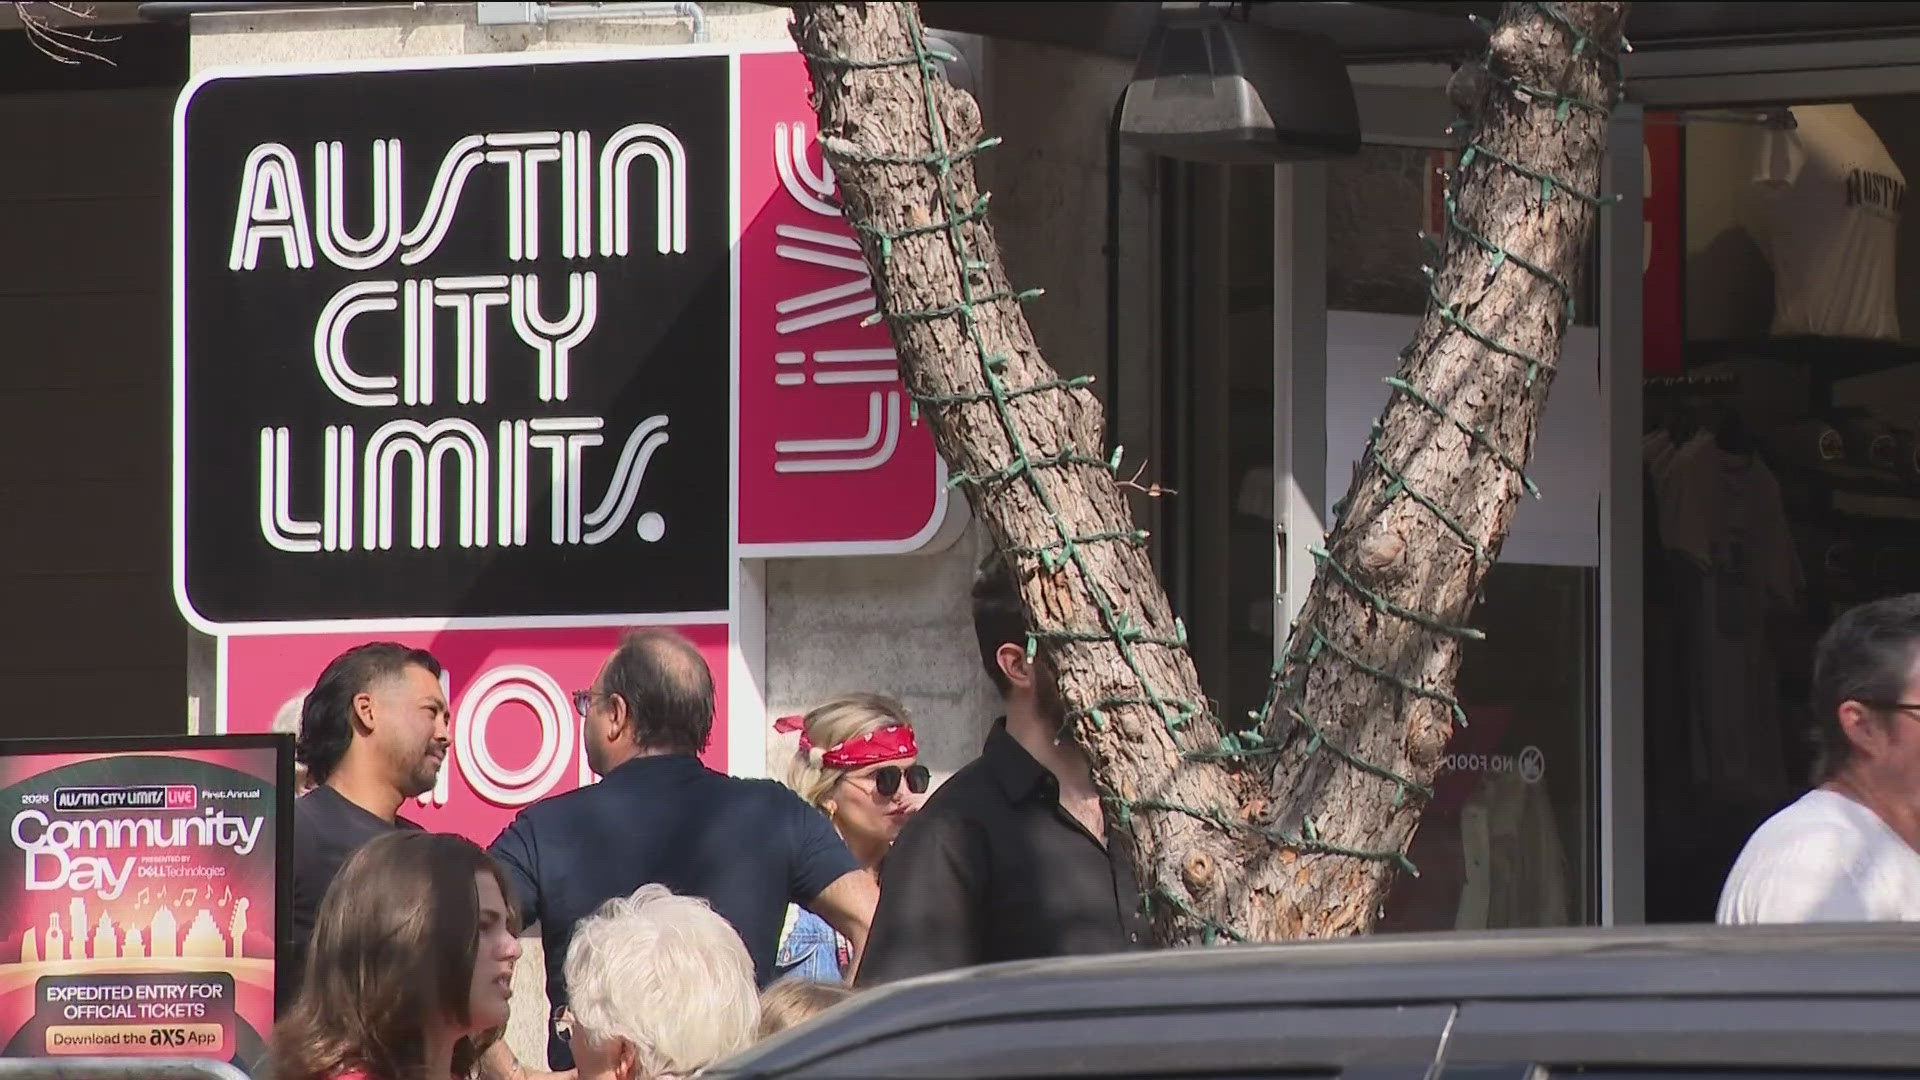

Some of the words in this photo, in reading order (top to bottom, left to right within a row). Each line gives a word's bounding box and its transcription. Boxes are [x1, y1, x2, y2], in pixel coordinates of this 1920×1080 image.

[228, 122, 688, 271] AUSTIN
[313, 271, 598, 407] CITY
[260, 414, 670, 553] LIMITS.
[59, 793, 99, 807] AUSTIN
[100, 792, 126, 805] CITY
[127, 791, 164, 805] LIMITS
[169, 790, 192, 804] LIVE
[202, 790, 225, 799] First
[227, 788, 260, 799] Annual
[11, 807, 265, 856] Community
[25, 848, 137, 901] Day
[141, 855, 181, 863] PRESENTED
[181, 855, 191, 863] BY
[46, 986, 133, 1002] EXPEDITED
[136, 984, 187, 1000] ENTRY
[190, 984, 222, 999] FOR
[63, 1003, 136, 1020] OFFICIAL
[138, 1002, 205, 1019] TICKETS
[54, 1032, 120, 1046] Download
[124, 1032, 146, 1045] the
[188, 1031, 216, 1046] App
